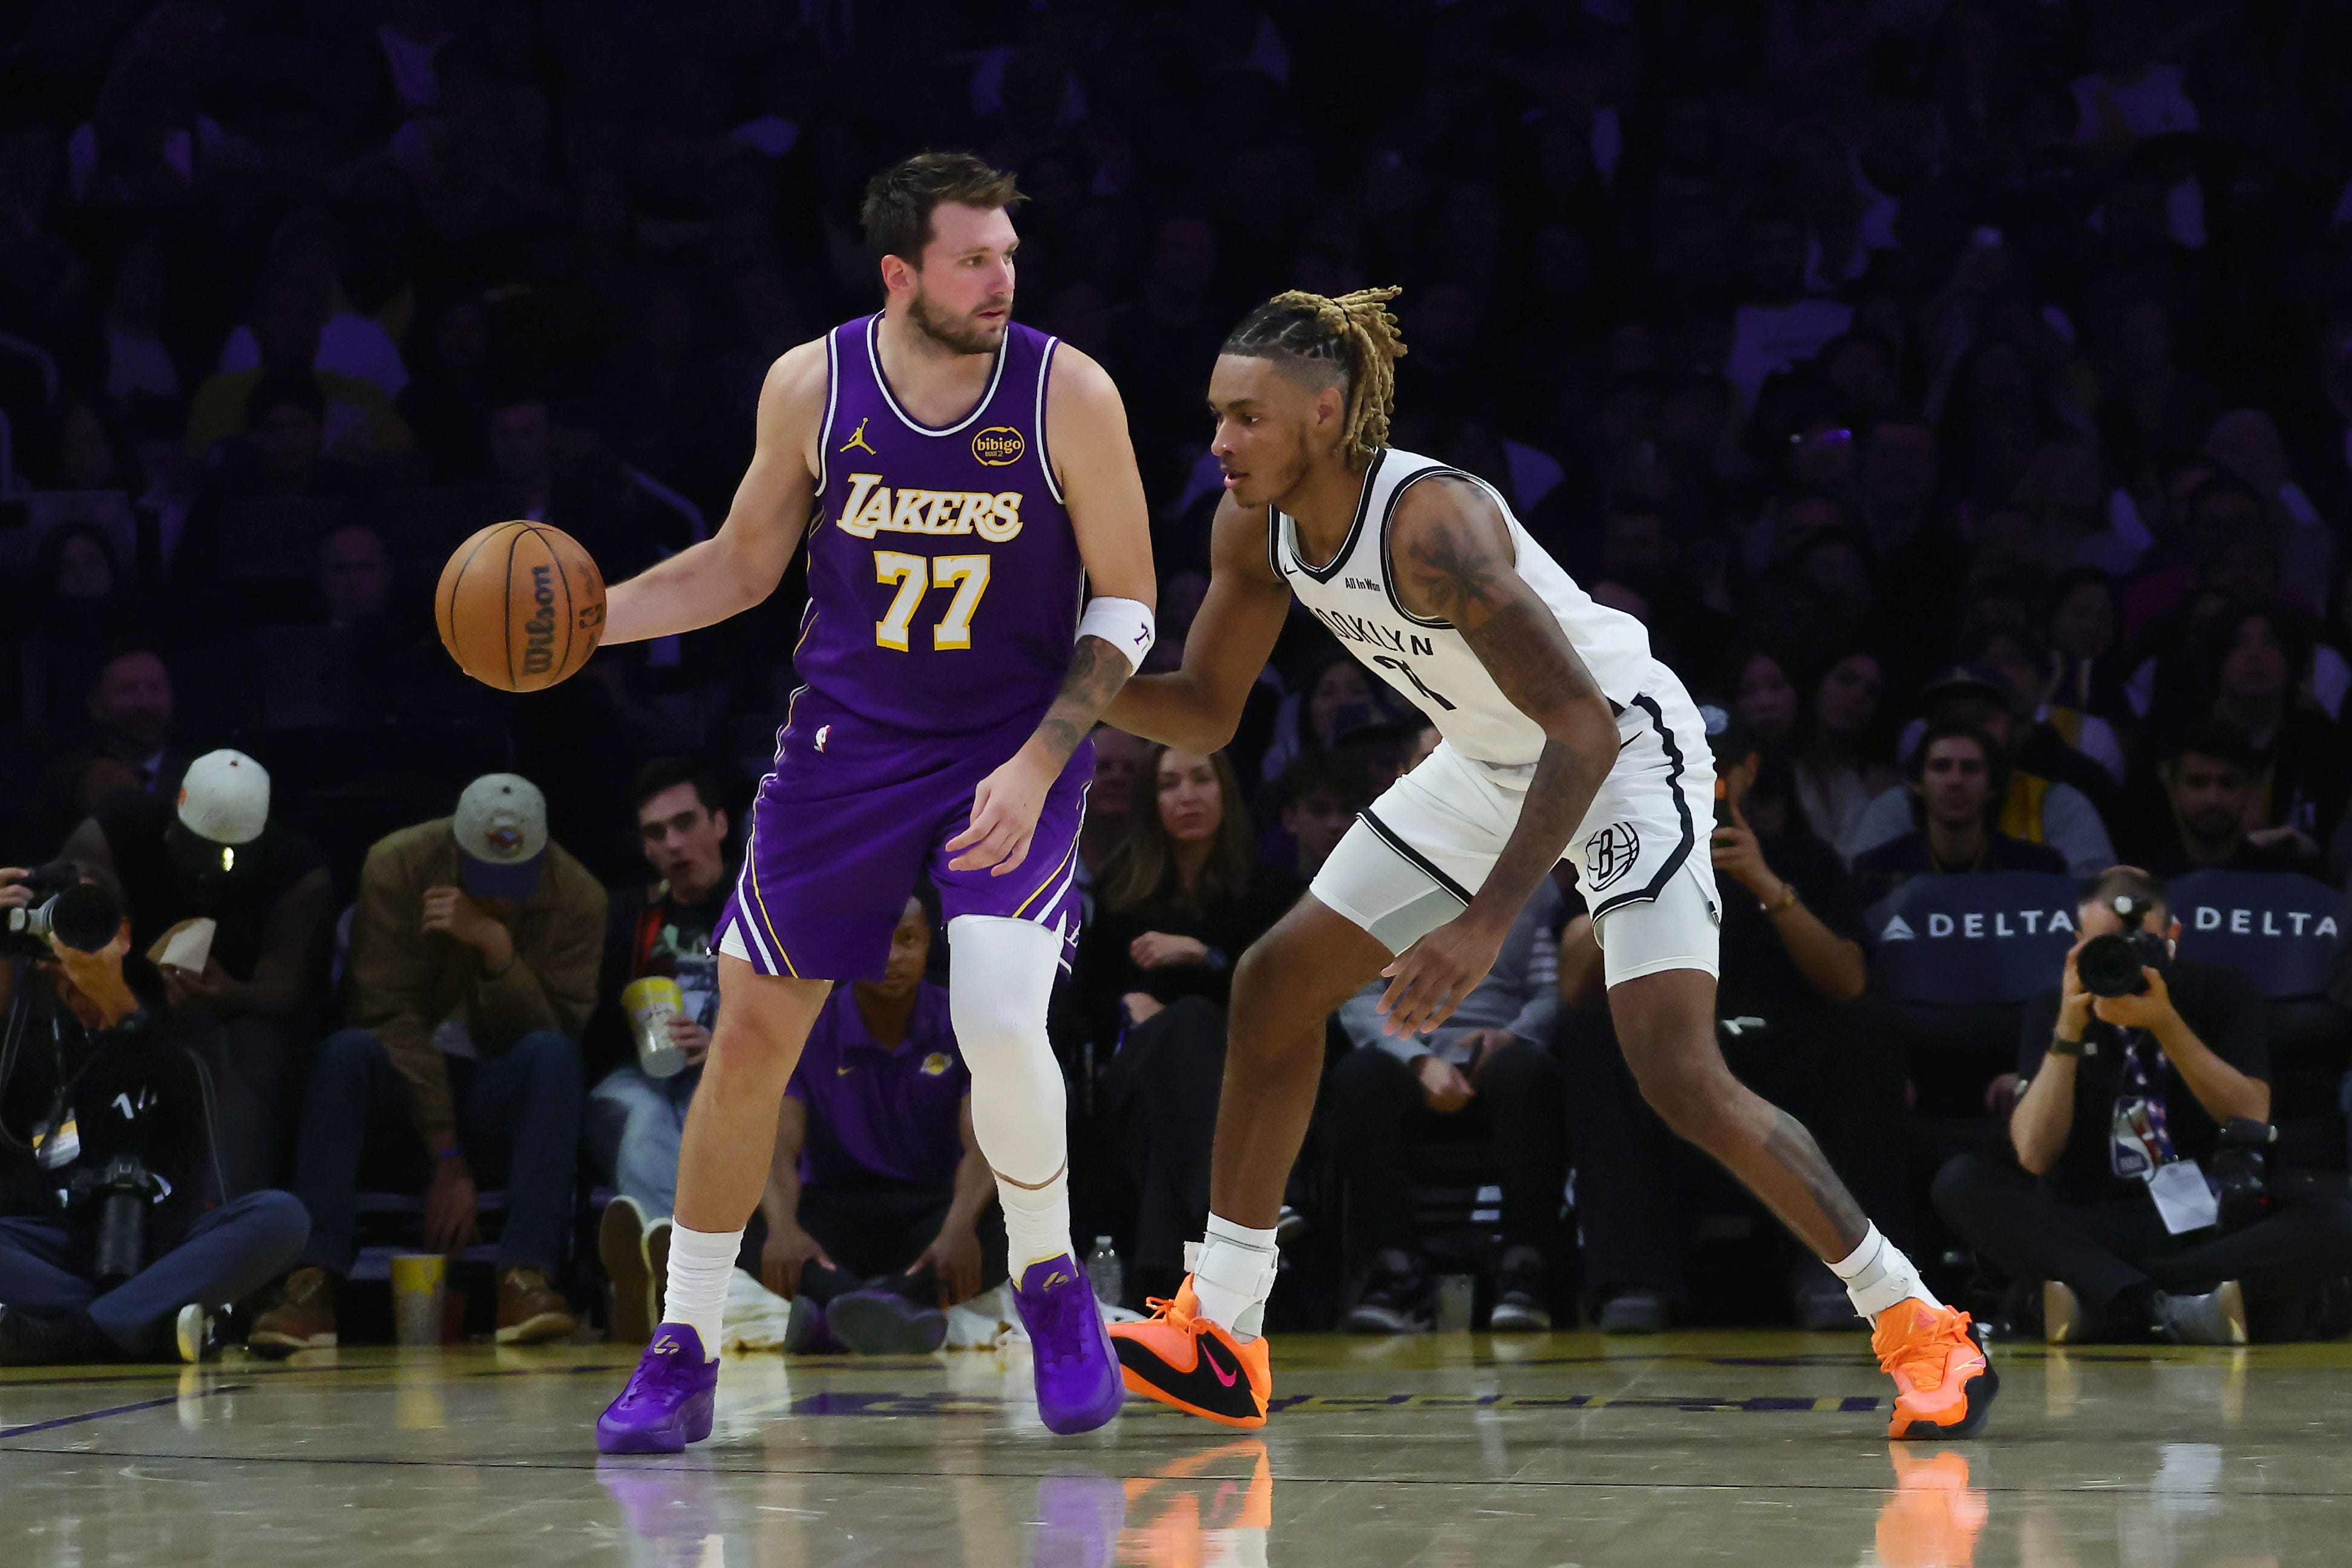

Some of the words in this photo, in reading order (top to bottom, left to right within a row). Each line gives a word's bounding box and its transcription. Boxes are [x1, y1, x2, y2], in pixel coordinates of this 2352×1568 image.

[977, 437, 1021, 454] bibigo
[1345, 577, 1356, 589] All
[1356, 578, 1366, 589] In
[873, 550, 991, 652] 77
[522, 566, 555, 676] Wilson
[1309, 607, 1434, 656] OOKLYN
[1928, 909, 2074, 938] DELTA
[2196, 906, 2337, 937] DELTA
